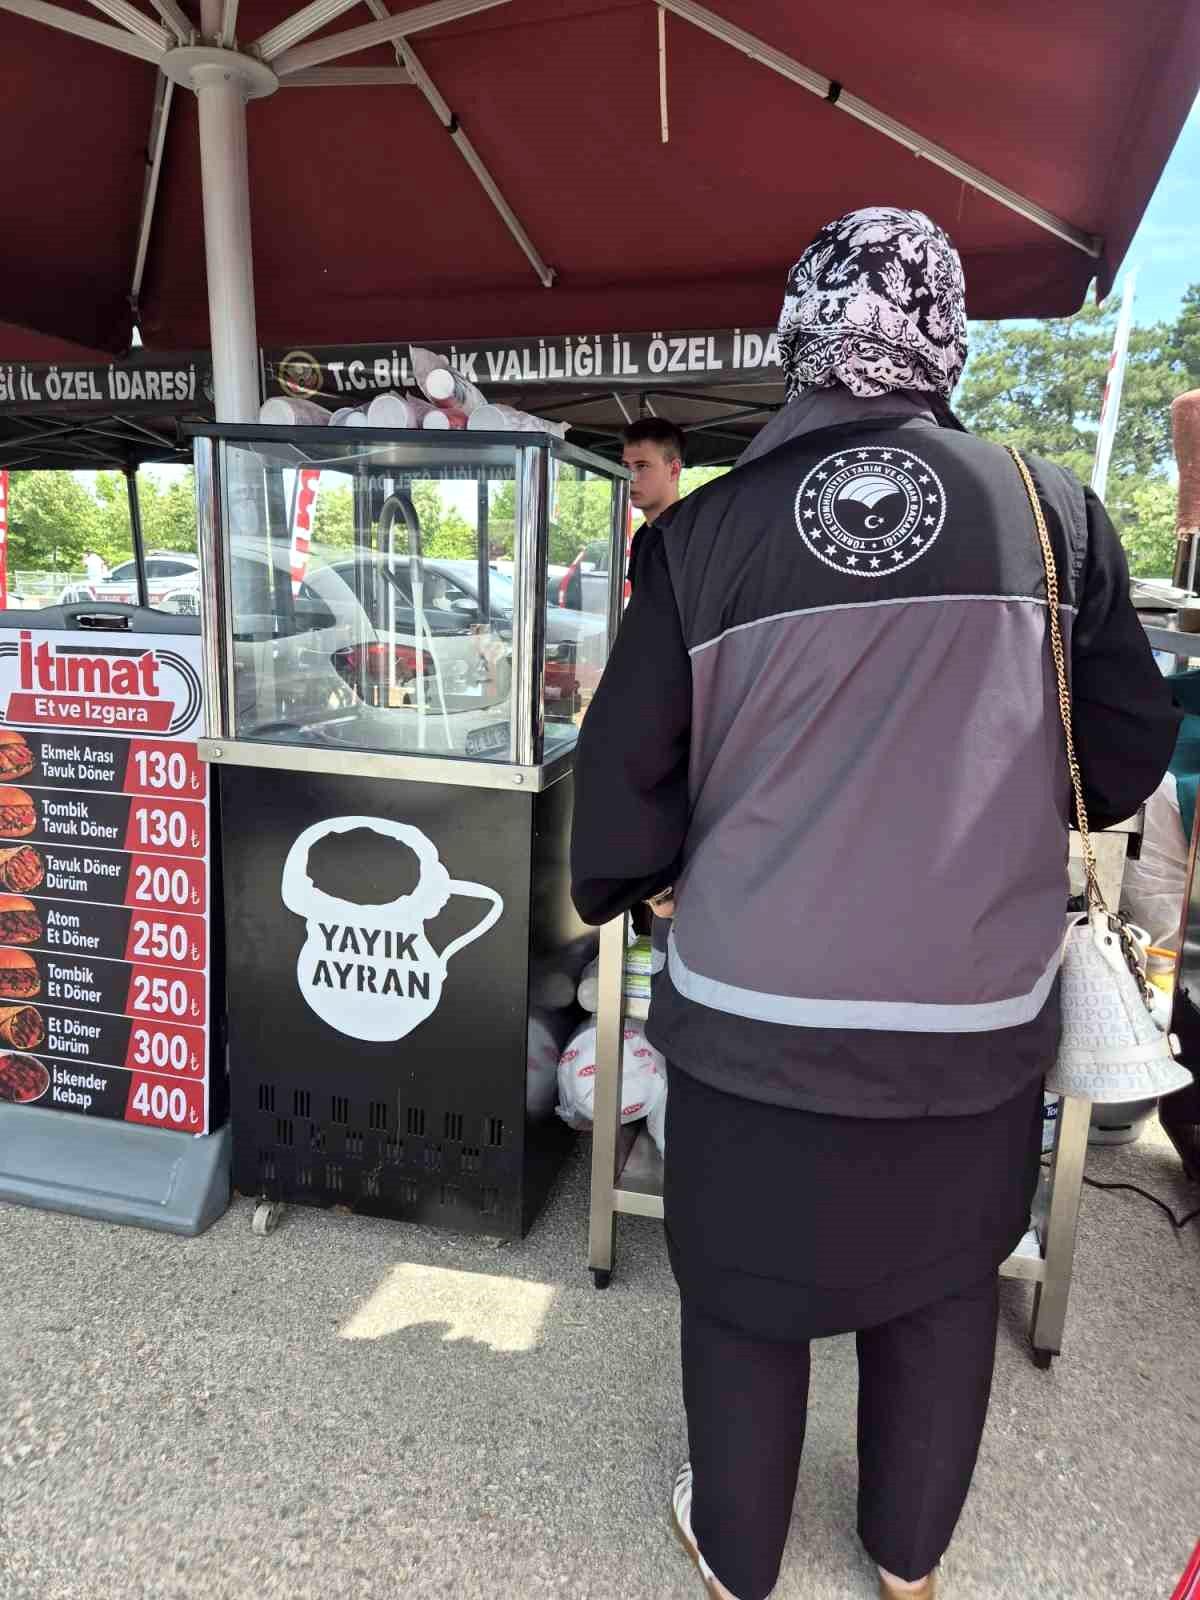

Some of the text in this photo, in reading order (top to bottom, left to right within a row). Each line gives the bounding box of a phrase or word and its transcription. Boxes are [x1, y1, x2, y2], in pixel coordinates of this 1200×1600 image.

[486, 335, 602, 382] VALİLİĞİ
[613, 334, 639, 375] İL
[647, 332, 723, 373] ÖZEL
[20, 366, 42, 400] İL
[45, 366, 103, 400] ÖZEL
[108, 363, 197, 400] İDARESİ
[829, 525, 866, 549] TÜRKİYE
[884, 467, 897, 477] VE
[896, 475, 917, 502] ORMAN
[34, 699, 148, 724] Et ve Izgara
[41, 744, 114, 763] Ekmek Arası
[41, 762, 116, 782] Tavuk Döner
[42, 799, 89, 818] Tombik
[42, 818, 119, 839] Tavuk Döner
[45, 855, 121, 877] Tavuk Döner
[46, 873, 88, 892] Dürüm
[47, 910, 80, 927] Atom
[47, 928, 100, 949] Et Döner
[318, 922, 420, 962] YAYIK
[48, 964, 94, 983] Tombik
[312, 960, 430, 1000] AYRAN
[48, 983, 101, 1003] Et Döner
[48, 1017, 101, 1039] Et Döner
[48, 1035, 90, 1055] Dürüm
[53, 1065, 107, 1091] İskender
[53, 1087, 92, 1108] Kebap
